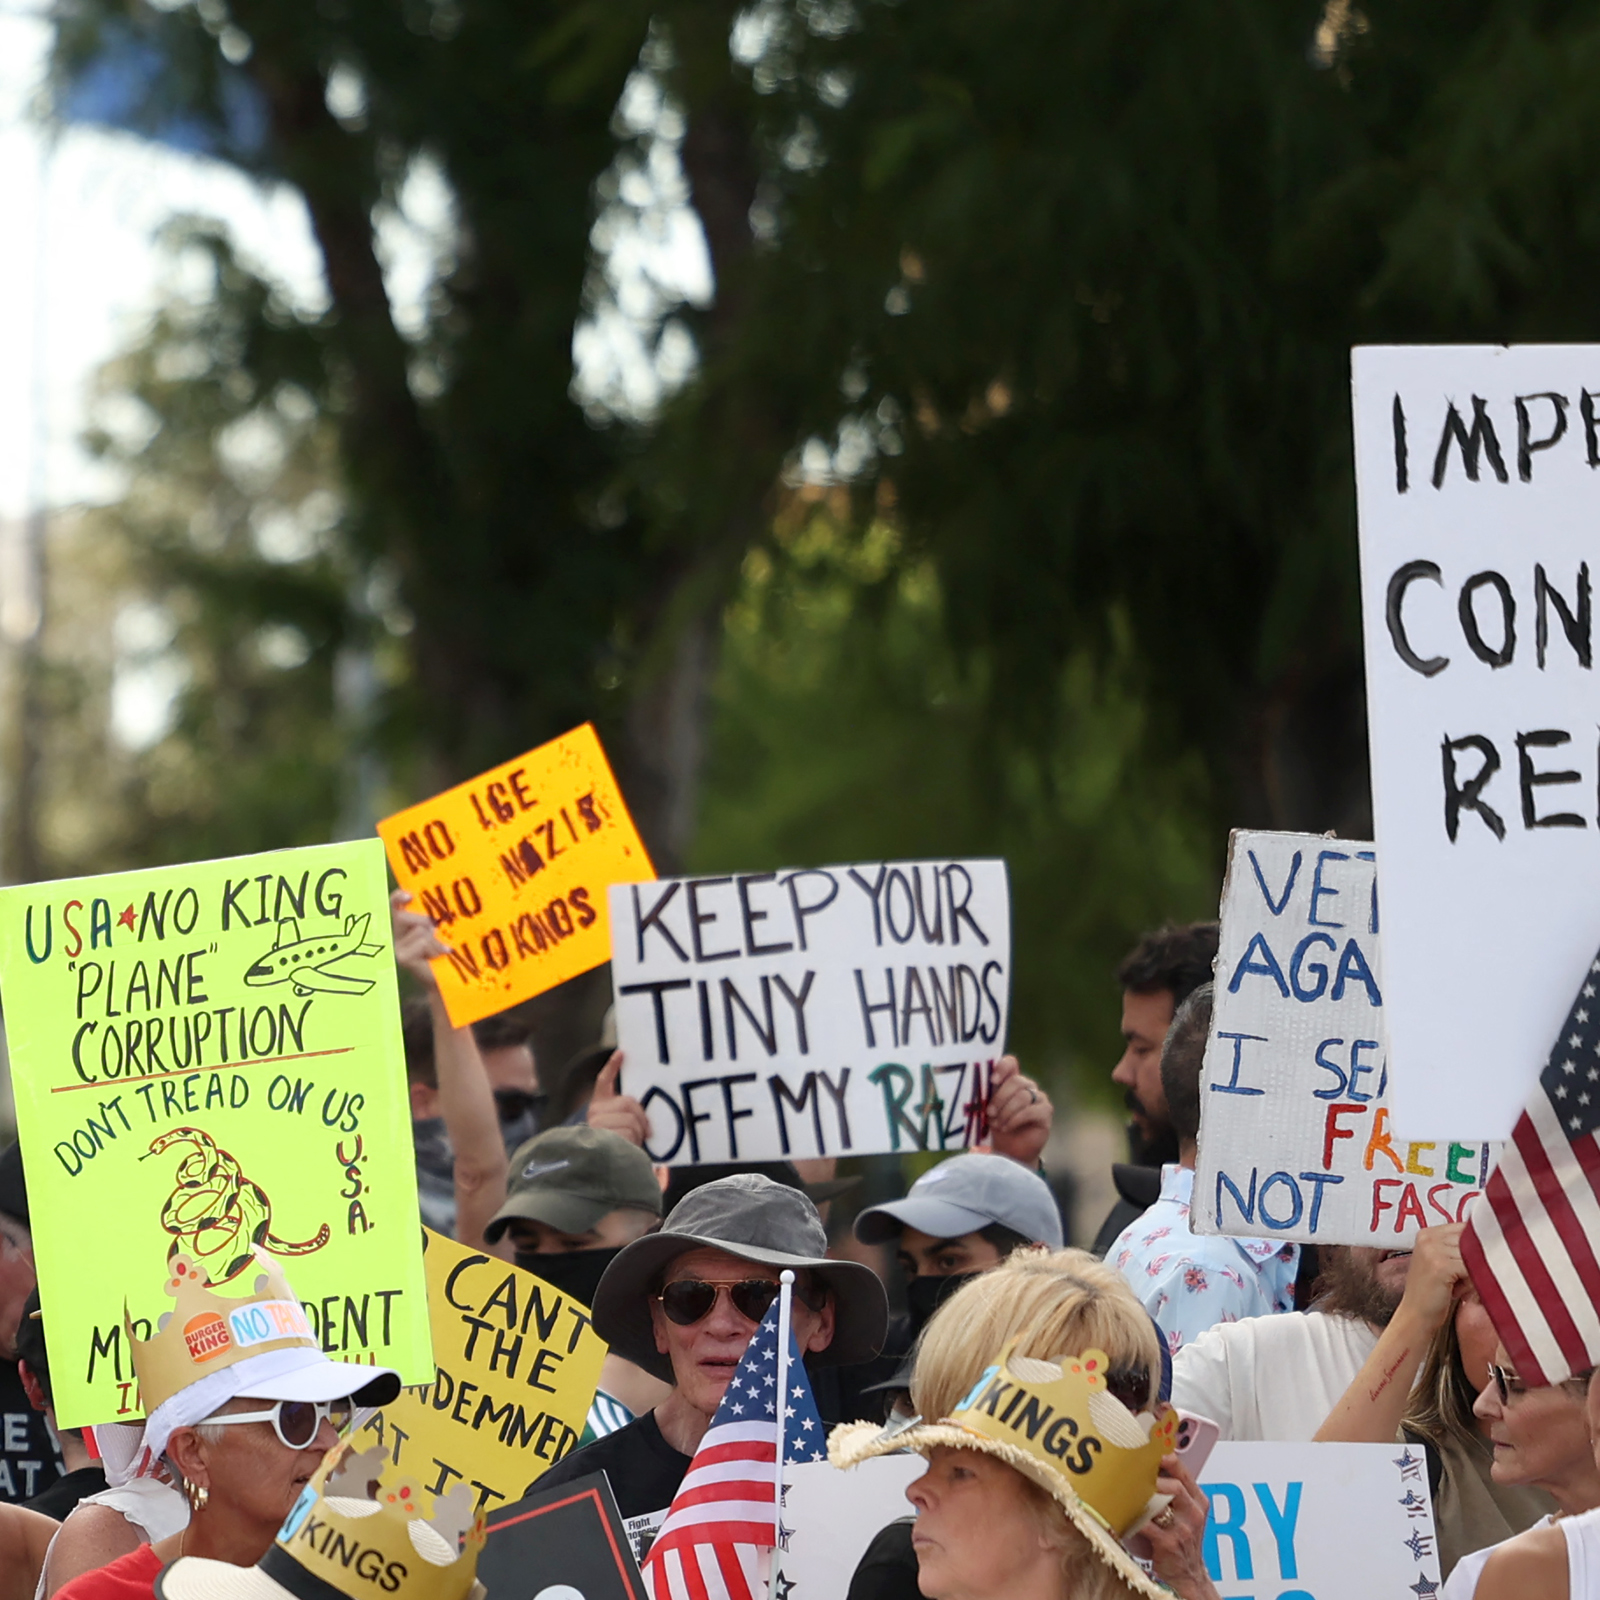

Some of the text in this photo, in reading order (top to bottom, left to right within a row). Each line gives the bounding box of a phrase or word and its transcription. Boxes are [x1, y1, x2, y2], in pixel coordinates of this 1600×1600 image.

[26, 868, 348, 964] USA NO KING
[632, 863, 990, 964] KEEP YOUR
[68, 942, 219, 1019] "PLANE"
[619, 961, 1003, 1065] TINY HANDS
[72, 1000, 314, 1083] CORRUPTION
[1210, 1031, 1269, 1096] I
[135, 1073, 250, 1123] TREAD
[268, 1075, 315, 1115] ON
[322, 1088, 365, 1132] US
[639, 1072, 757, 1164] OFF
[767, 1066, 850, 1156] MY
[1216, 1167, 1345, 1235] NOT
[185, 1320, 226, 1346] BURGER
[188, 1330, 230, 1358] KING
[231, 1308, 270, 1343] NO
[461, 1315, 564, 1394] THE
[975, 1379, 1102, 1475] KINGS
[302, 1515, 408, 1593] KINGS
[628, 1518, 650, 1530] Fight
